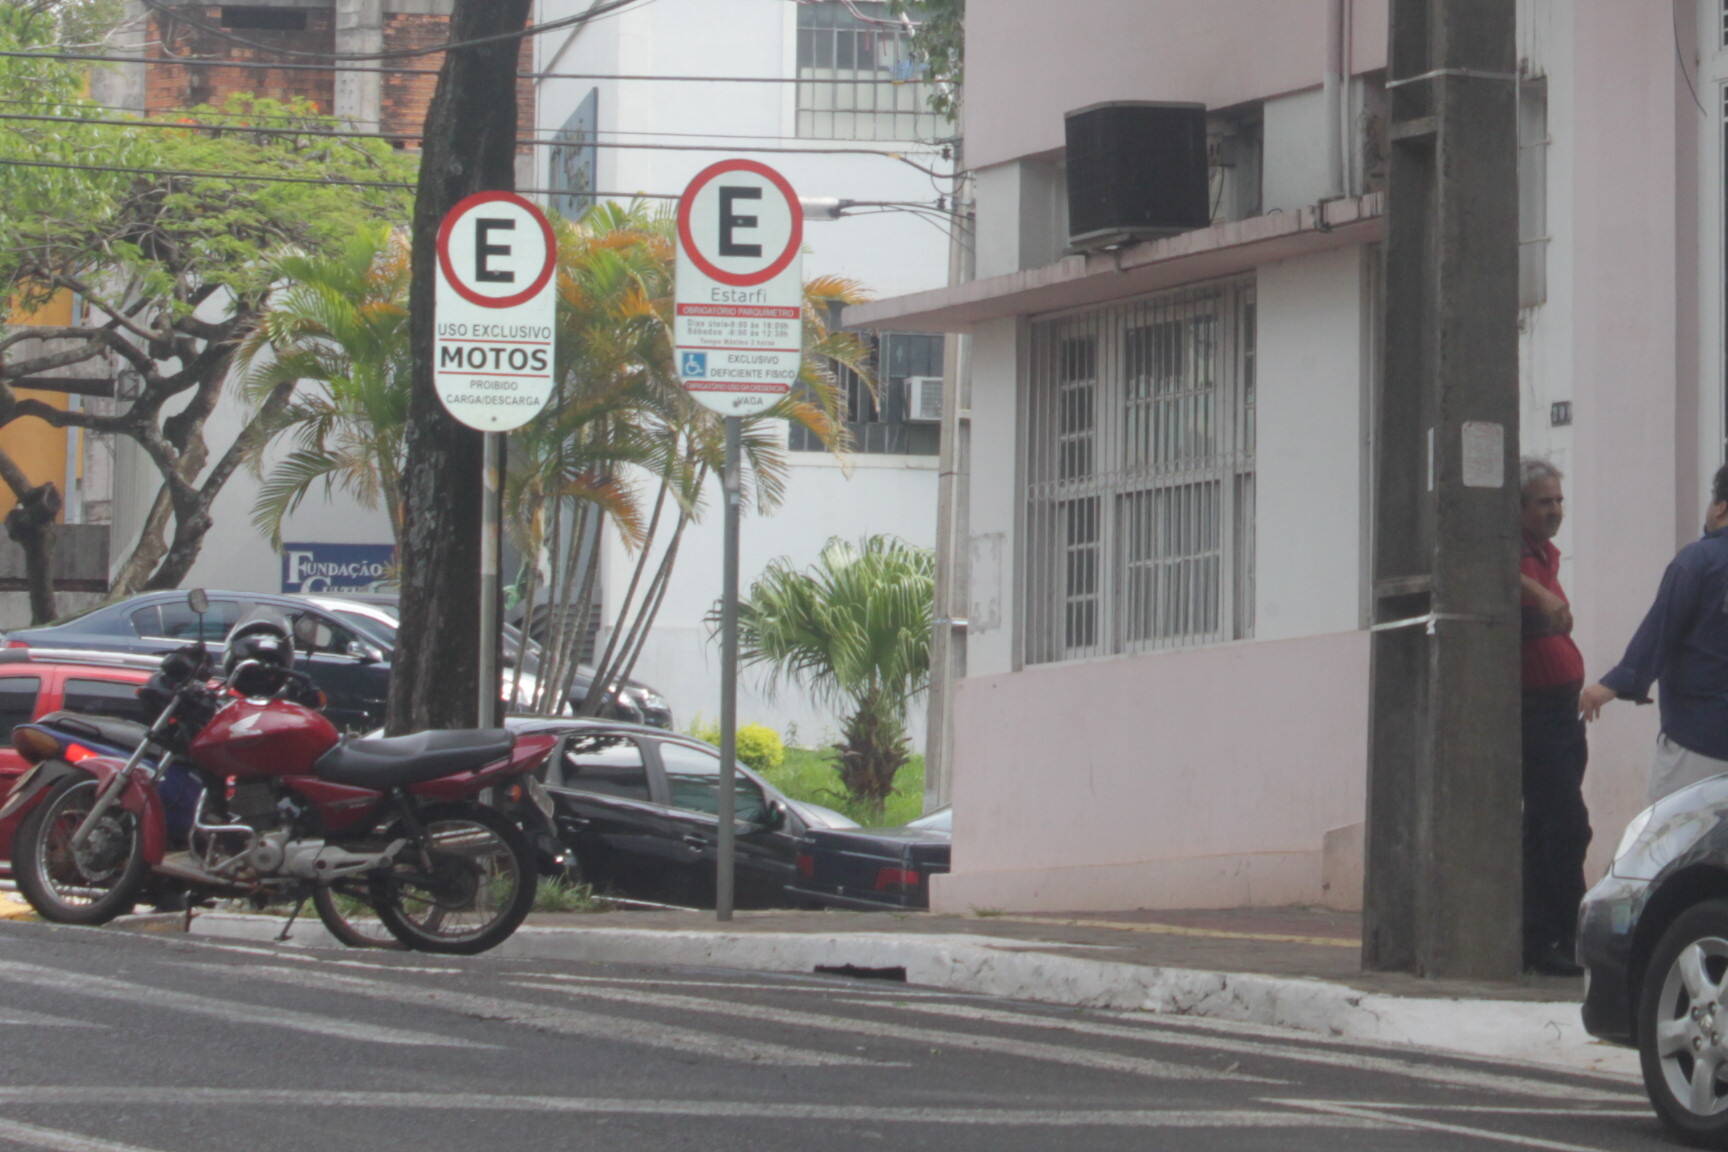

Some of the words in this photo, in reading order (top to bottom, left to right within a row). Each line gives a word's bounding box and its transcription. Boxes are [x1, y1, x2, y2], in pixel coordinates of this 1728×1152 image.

[719, 186, 763, 258] E
[475, 217, 516, 283] E
[711, 287, 768, 303] Estarfi
[437, 323, 468, 338] USO
[472, 323, 552, 340] EXCLUSIVO
[440, 345, 549, 372] MOTOS
[727, 353, 780, 365] EXCLUSIVO
[710, 368, 763, 379] DEFICIENTE
[469, 379, 519, 391] PROIBIDO
[446, 393, 541, 407] CARGA/DESCARGA
[286, 550, 383, 584] FUNDAÇÃO
